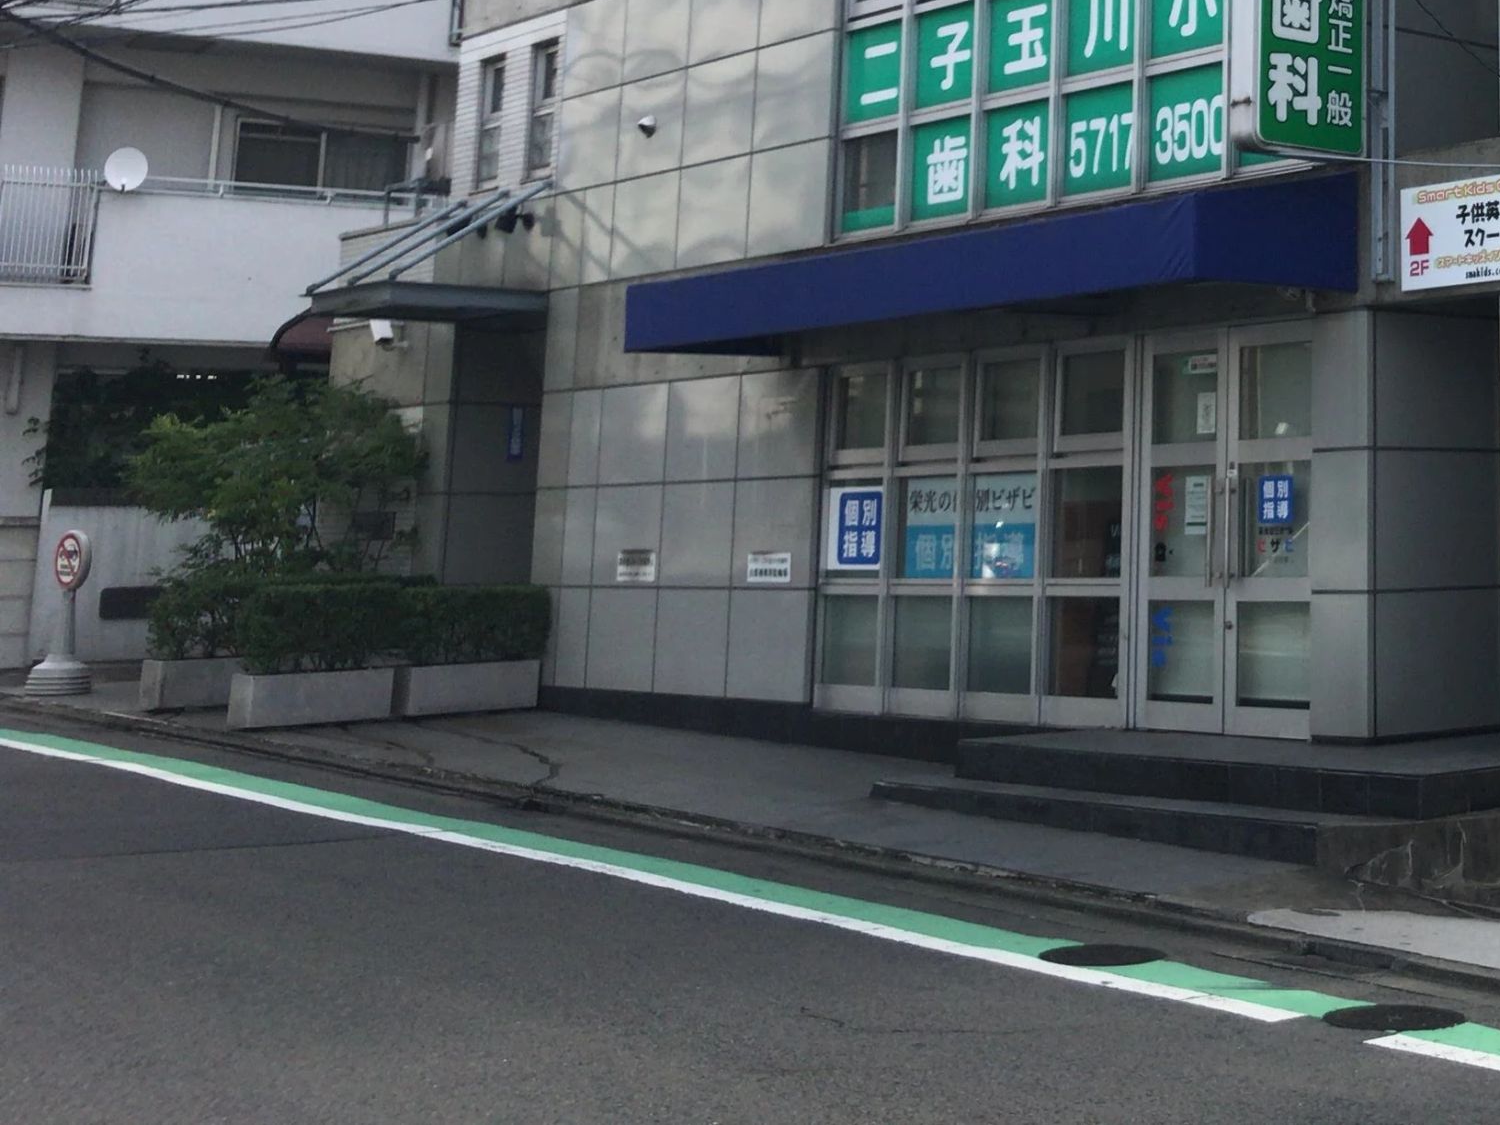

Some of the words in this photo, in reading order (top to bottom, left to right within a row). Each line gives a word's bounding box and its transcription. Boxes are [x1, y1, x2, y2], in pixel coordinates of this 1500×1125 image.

[926, 115, 1045, 205] 歯科
[1070, 113, 1133, 178] 5717
[1416, 185, 1463, 205] Smart
[1463, 181, 1496, 200] Kids
[1409, 259, 1430, 277] 2F
[1263, 480, 1289, 500] 個別
[844, 498, 877, 526] 個別
[1263, 500, 1289, 520] 指導
[843, 530, 876, 558] 指導
